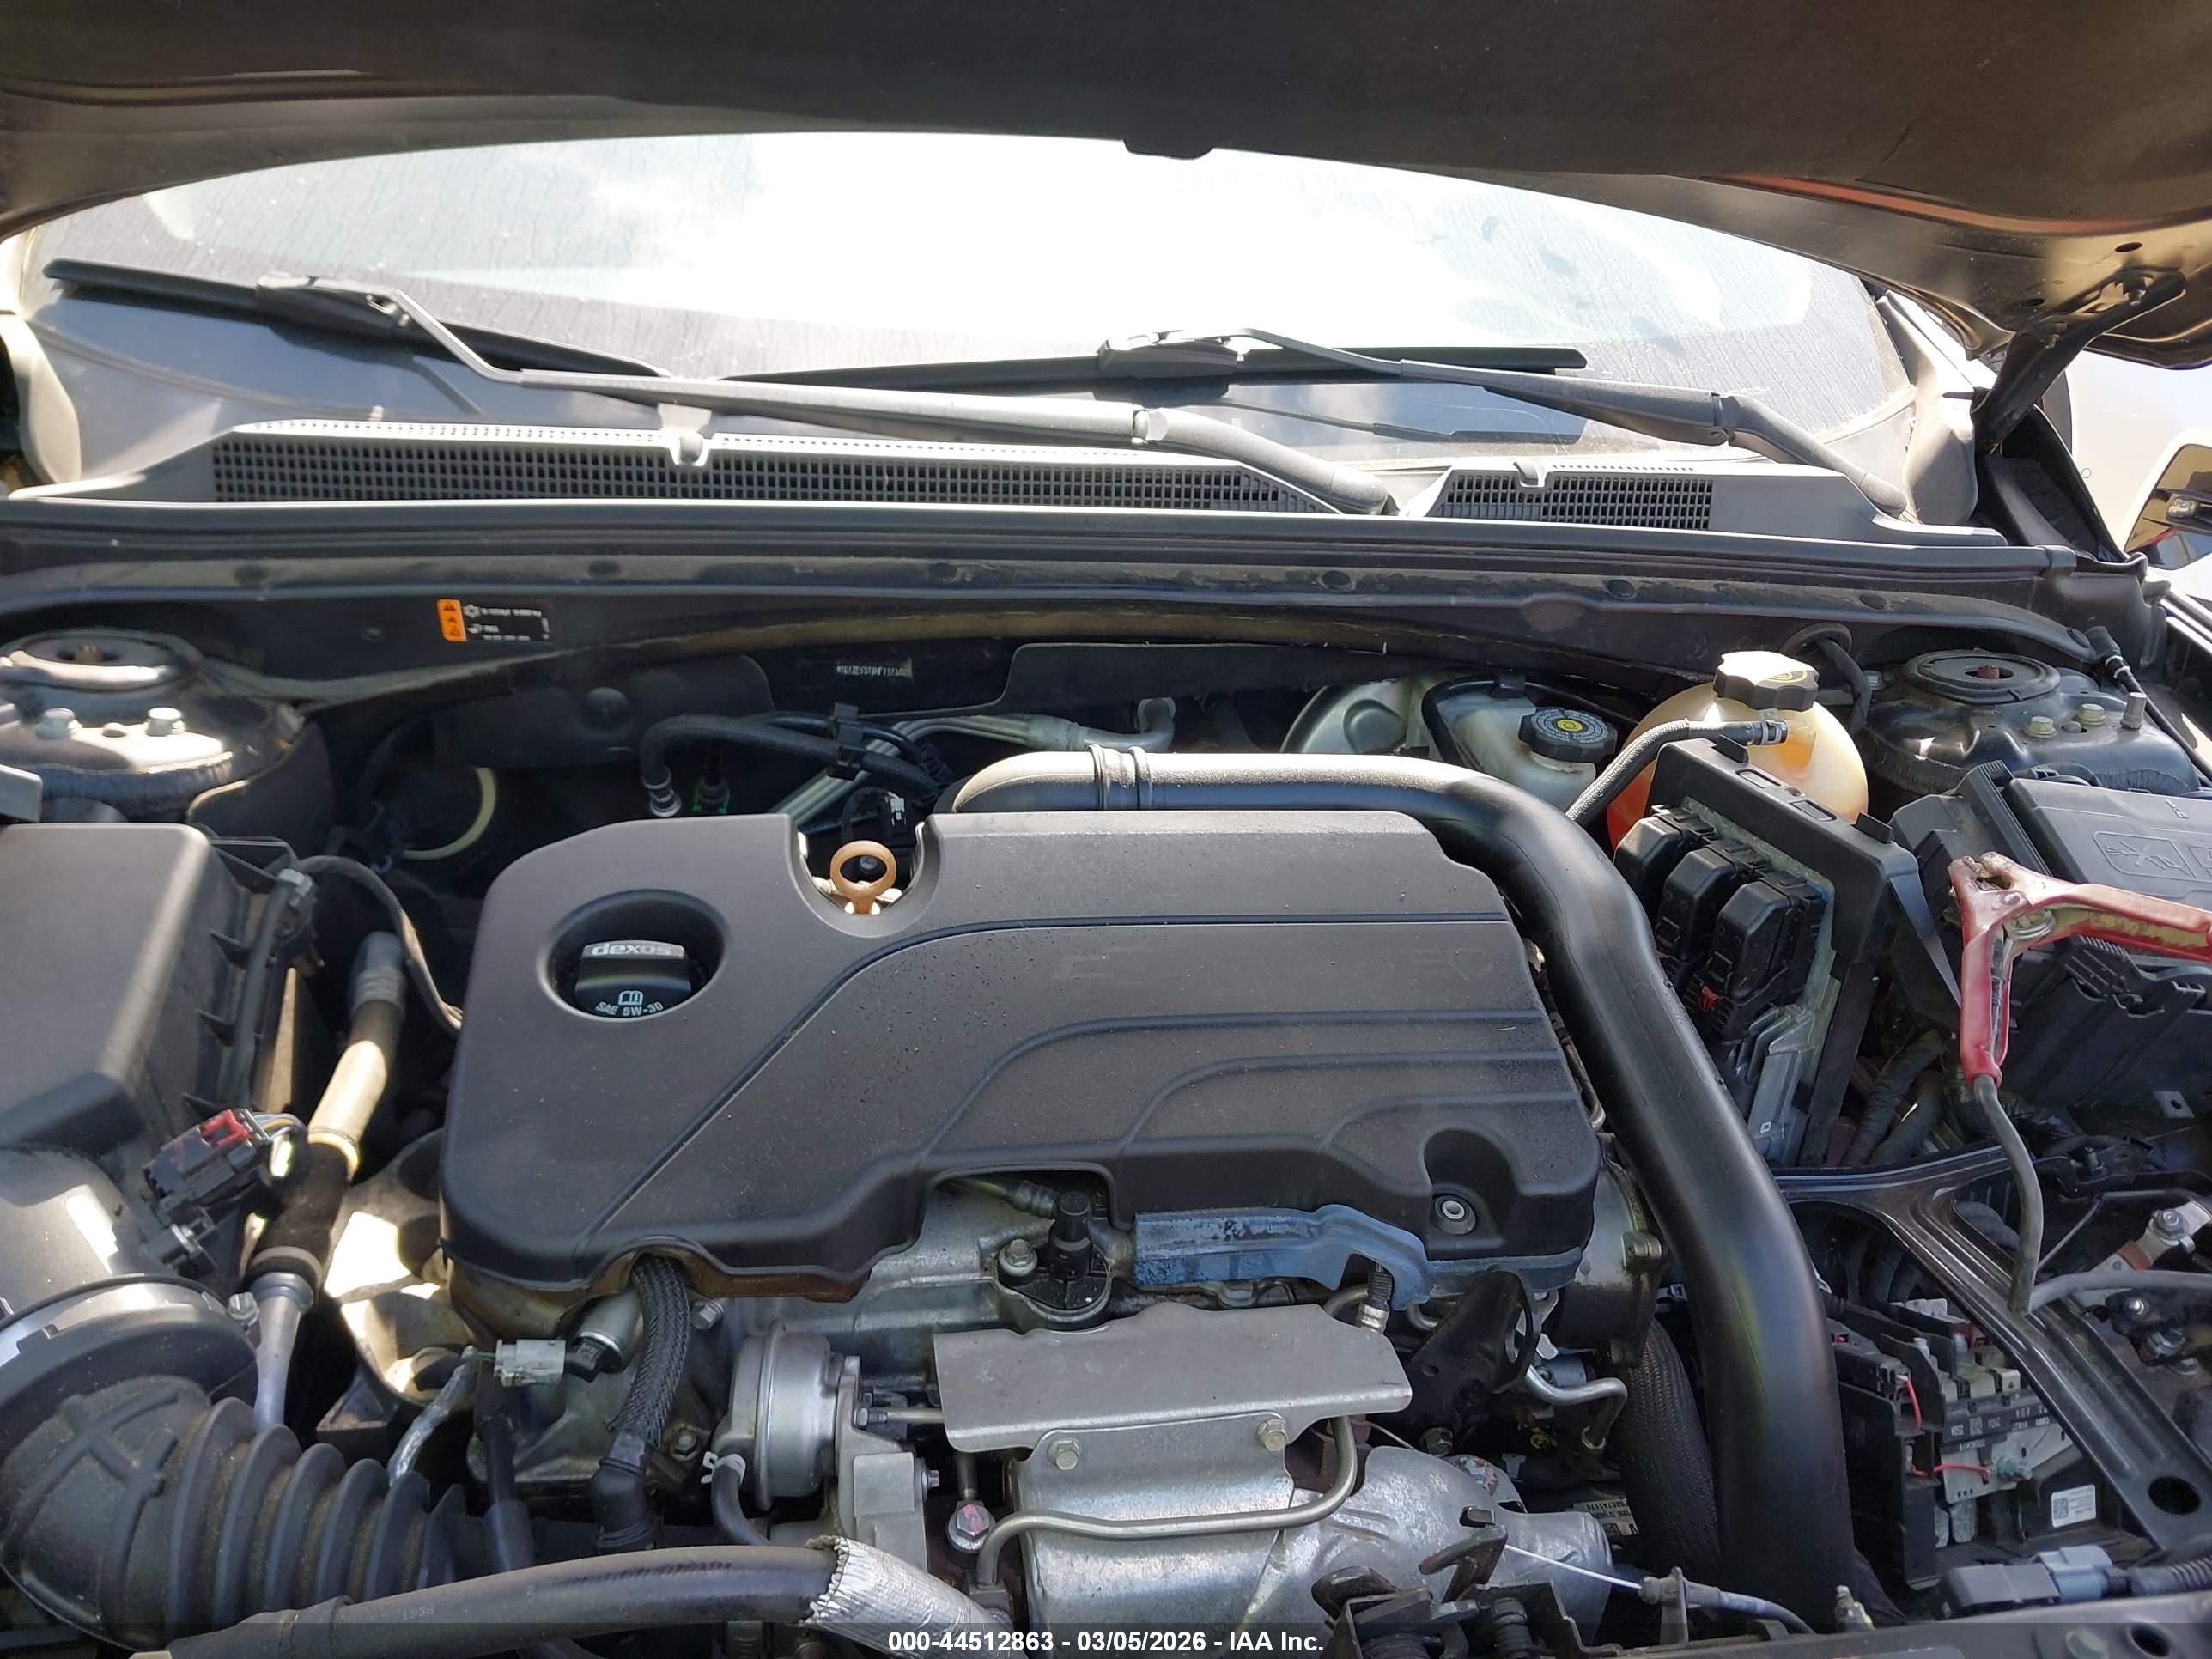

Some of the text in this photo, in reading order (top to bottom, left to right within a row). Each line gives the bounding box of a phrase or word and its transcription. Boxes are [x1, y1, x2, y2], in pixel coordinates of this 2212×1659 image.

[592, 943, 672, 956] dexos
[595, 1001, 665, 1018] SAE 5W-30
